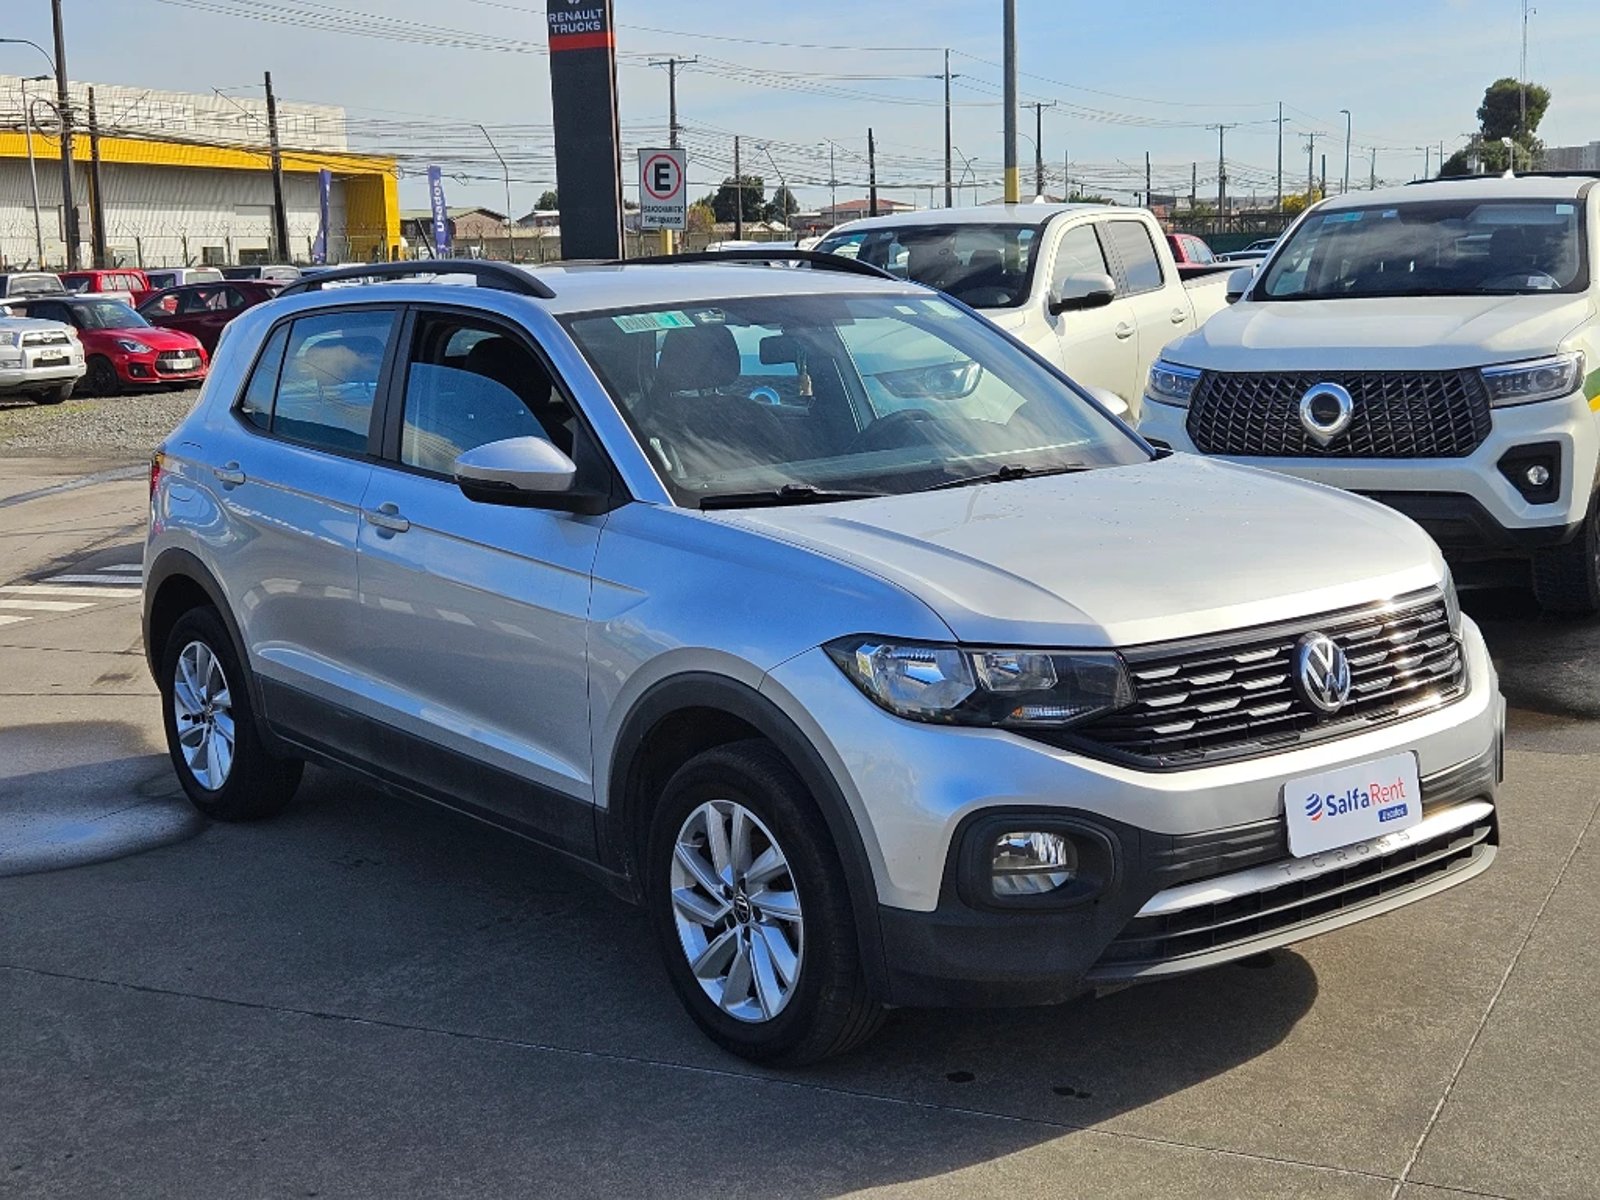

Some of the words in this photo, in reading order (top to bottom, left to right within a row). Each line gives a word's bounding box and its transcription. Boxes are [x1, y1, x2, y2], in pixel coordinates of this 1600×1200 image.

[548, 8, 603, 23] RENAULT
[552, 21, 601, 33] TRUCKS
[654, 163, 671, 191] E
[1326, 777, 1406, 816] SalfaRent
